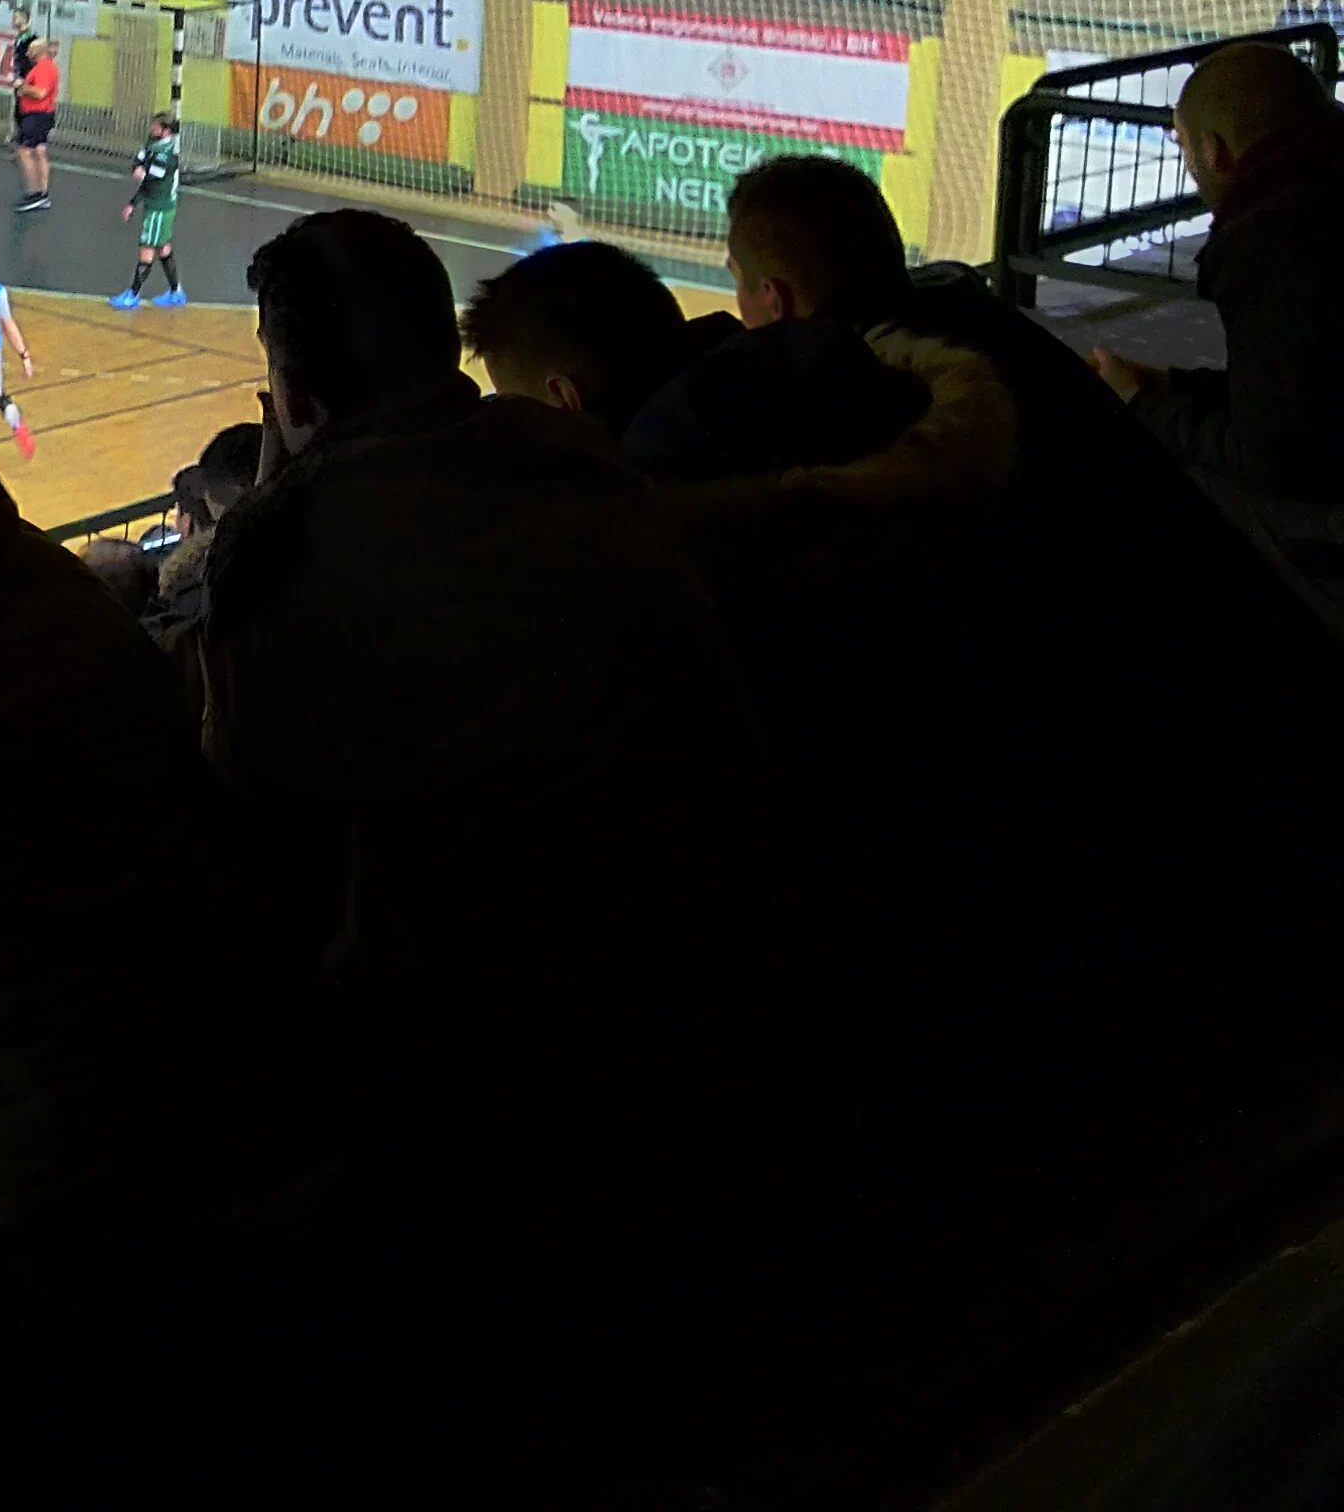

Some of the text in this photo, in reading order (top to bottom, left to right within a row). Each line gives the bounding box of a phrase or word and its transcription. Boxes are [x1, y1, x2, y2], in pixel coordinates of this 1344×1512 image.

[260, 77, 334, 138] bh
[620, 130, 766, 175] APOTEK
[655, 177, 728, 213] NER
